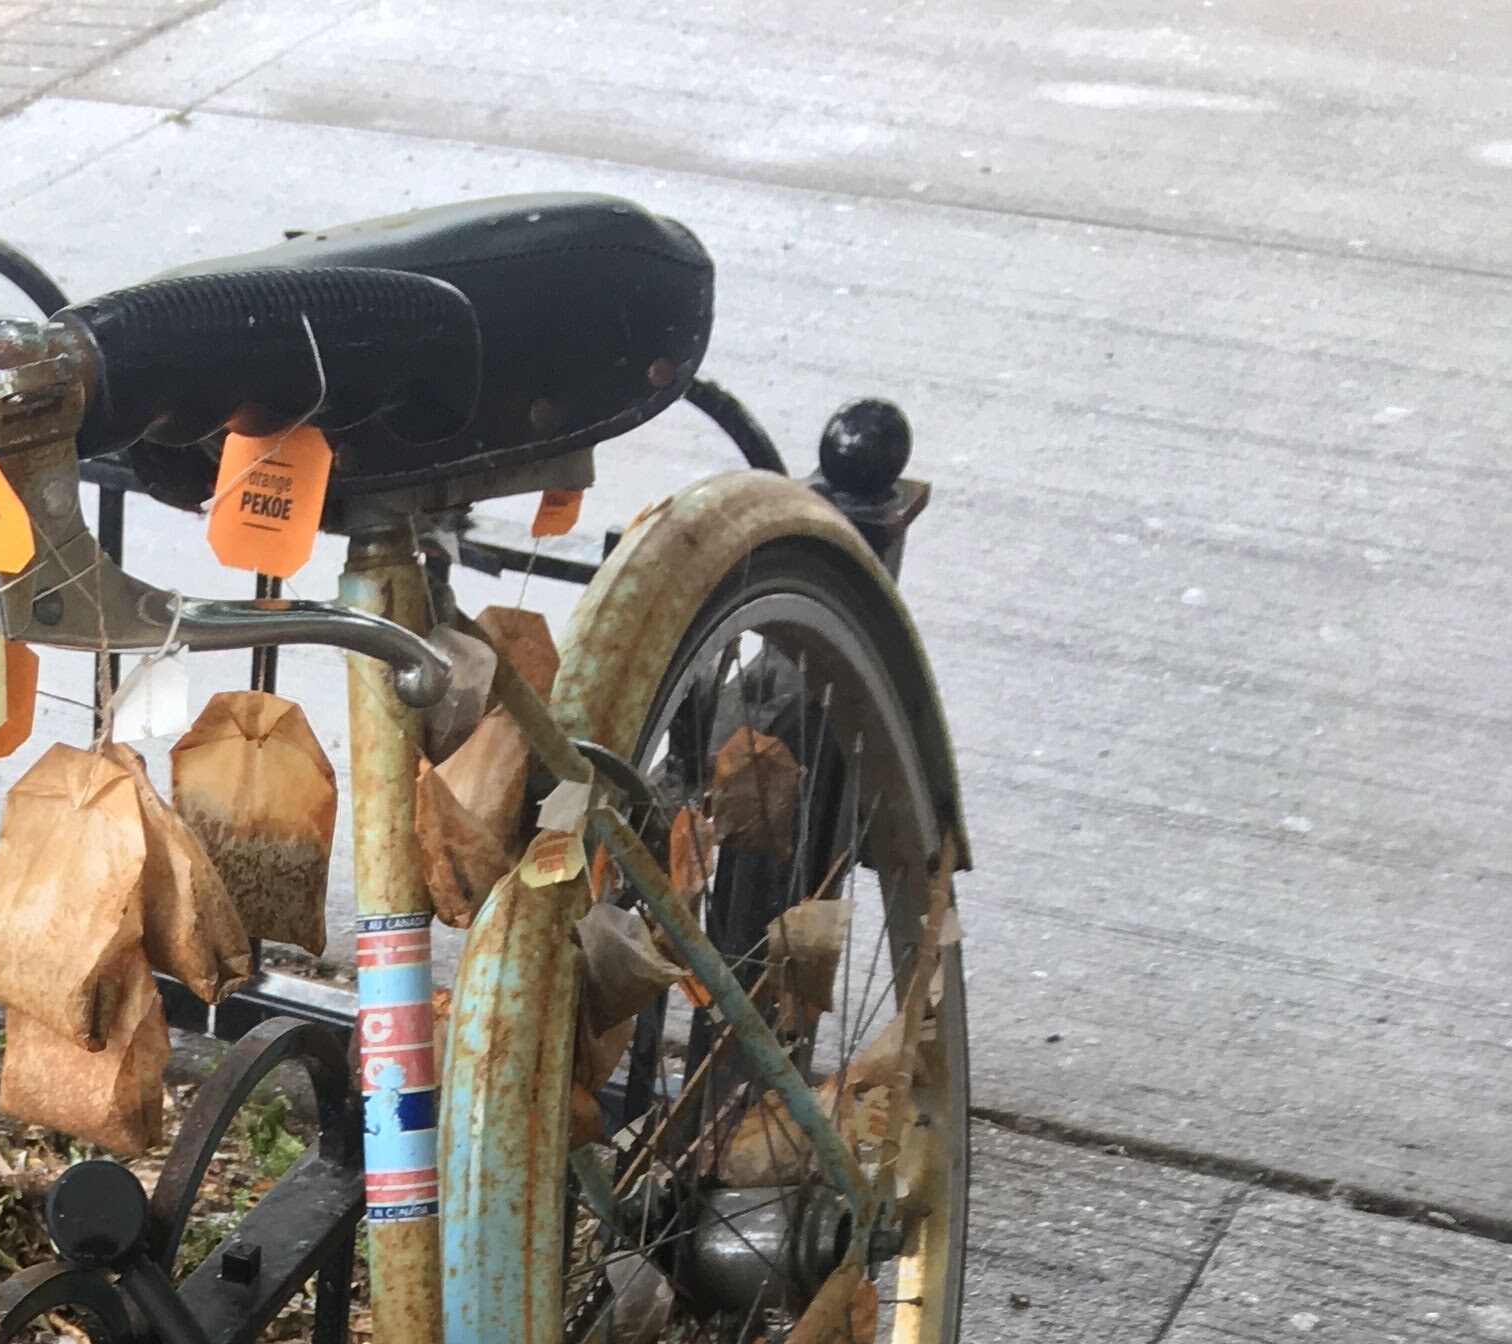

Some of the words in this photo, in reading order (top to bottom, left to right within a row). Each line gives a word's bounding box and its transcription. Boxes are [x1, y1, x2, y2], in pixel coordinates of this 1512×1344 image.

[248, 470, 293, 496] orange
[239, 489, 294, 521] PEKOE
[362, 1012, 393, 1044] C
